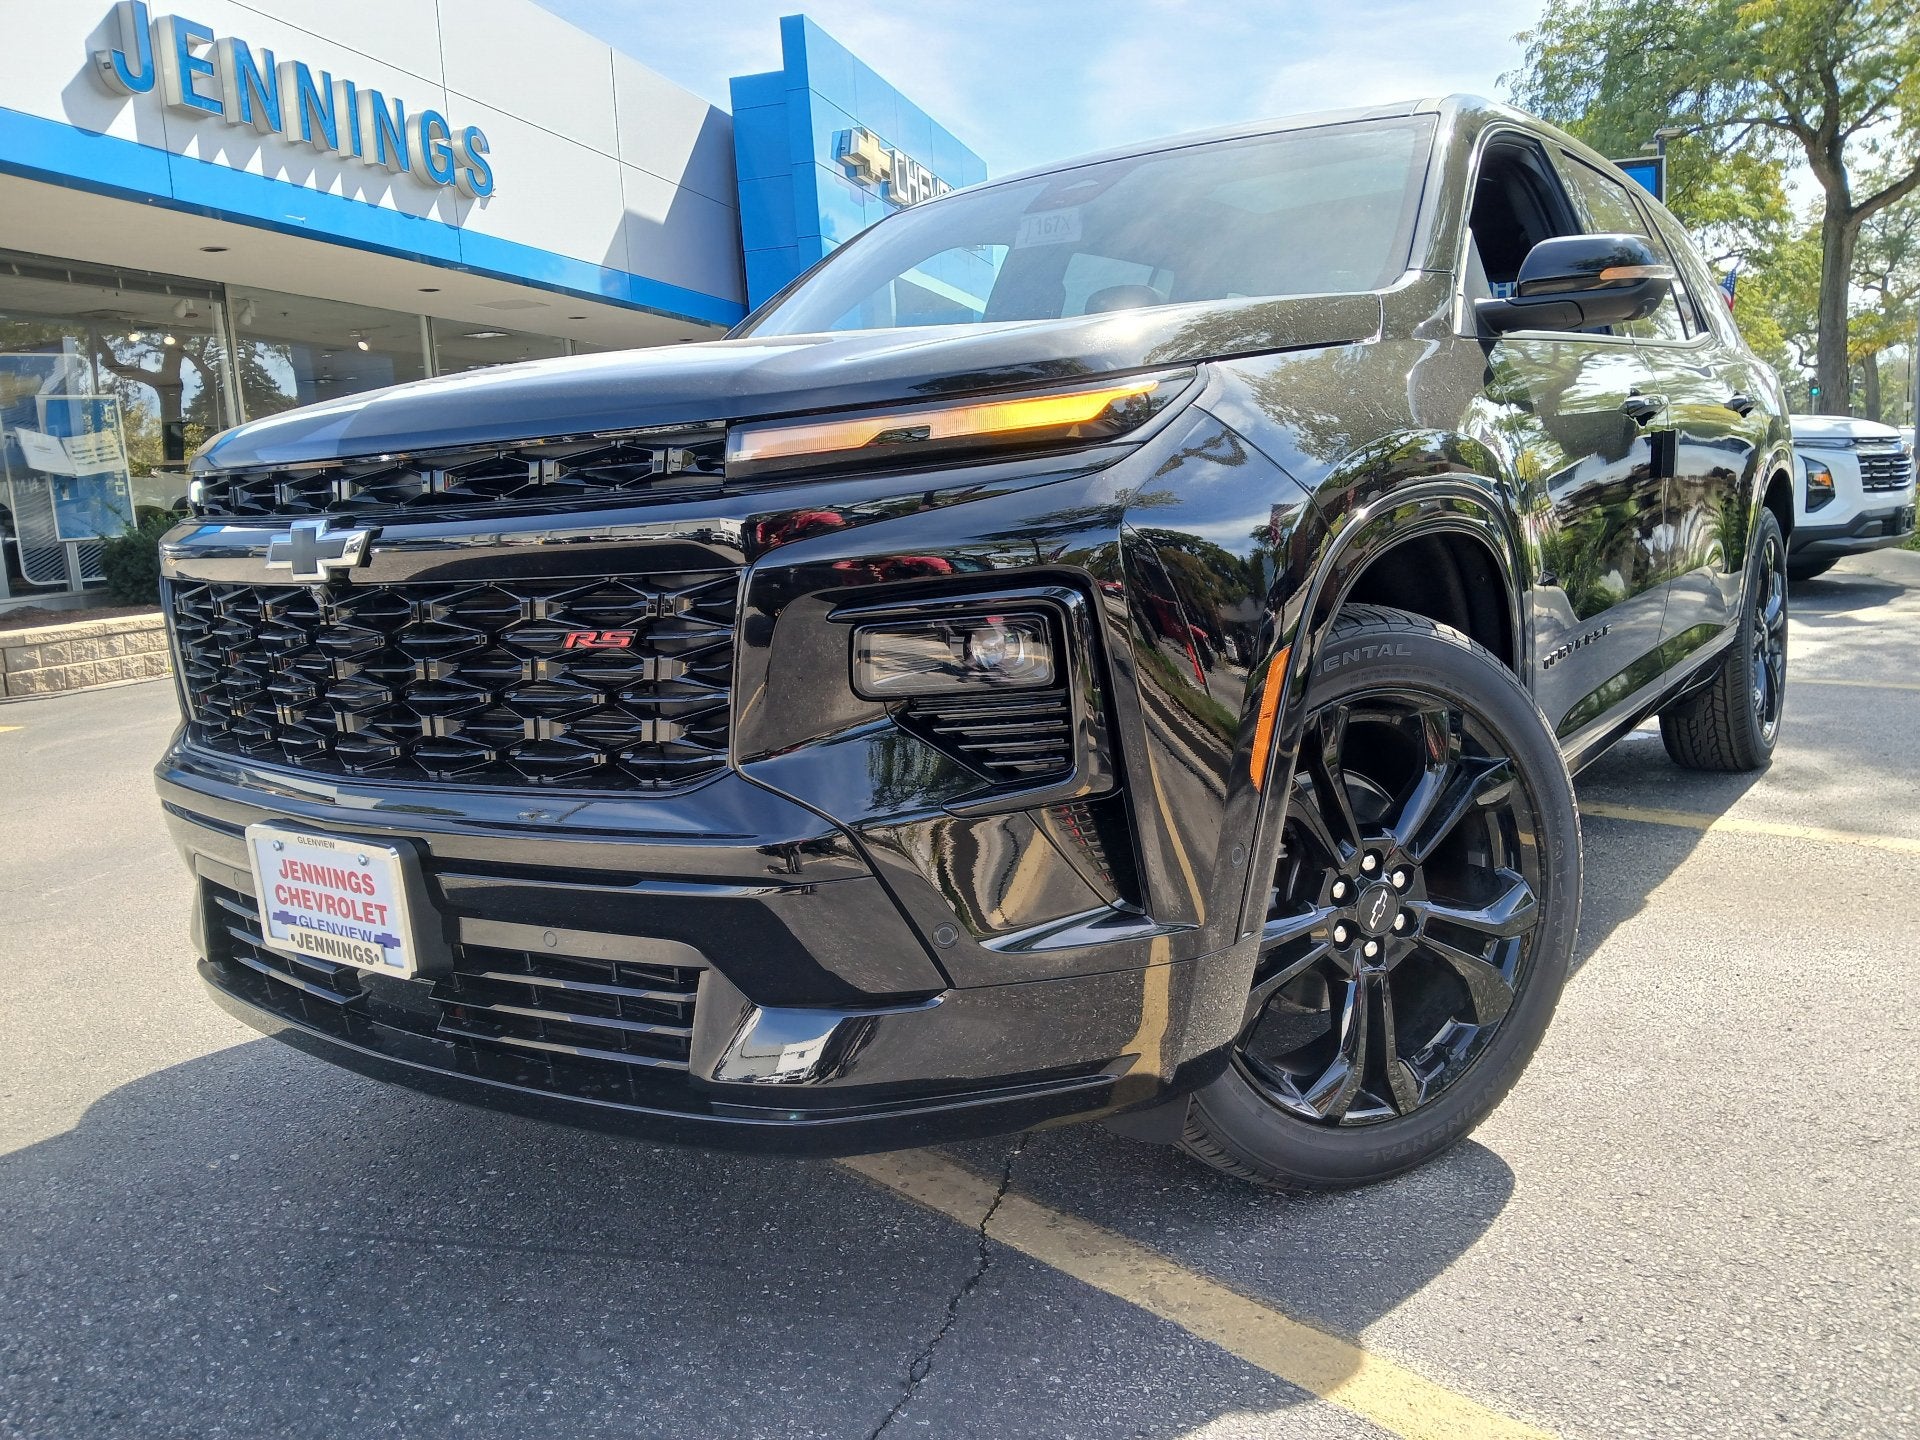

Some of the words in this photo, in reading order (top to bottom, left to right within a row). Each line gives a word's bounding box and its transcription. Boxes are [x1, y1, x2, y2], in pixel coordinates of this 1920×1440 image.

[94, 0, 496, 199] JENNINGS
[562, 630, 636, 649] RS
[1316, 643, 1413, 676] ENTAL
[297, 836, 335, 849] GLENVIEW
[279, 858, 375, 896] JENNINGS
[275, 884, 387, 926] CHEVROLET
[299, 915, 372, 942] GLENVIEW
[294, 932, 376, 966] JENNINGS
